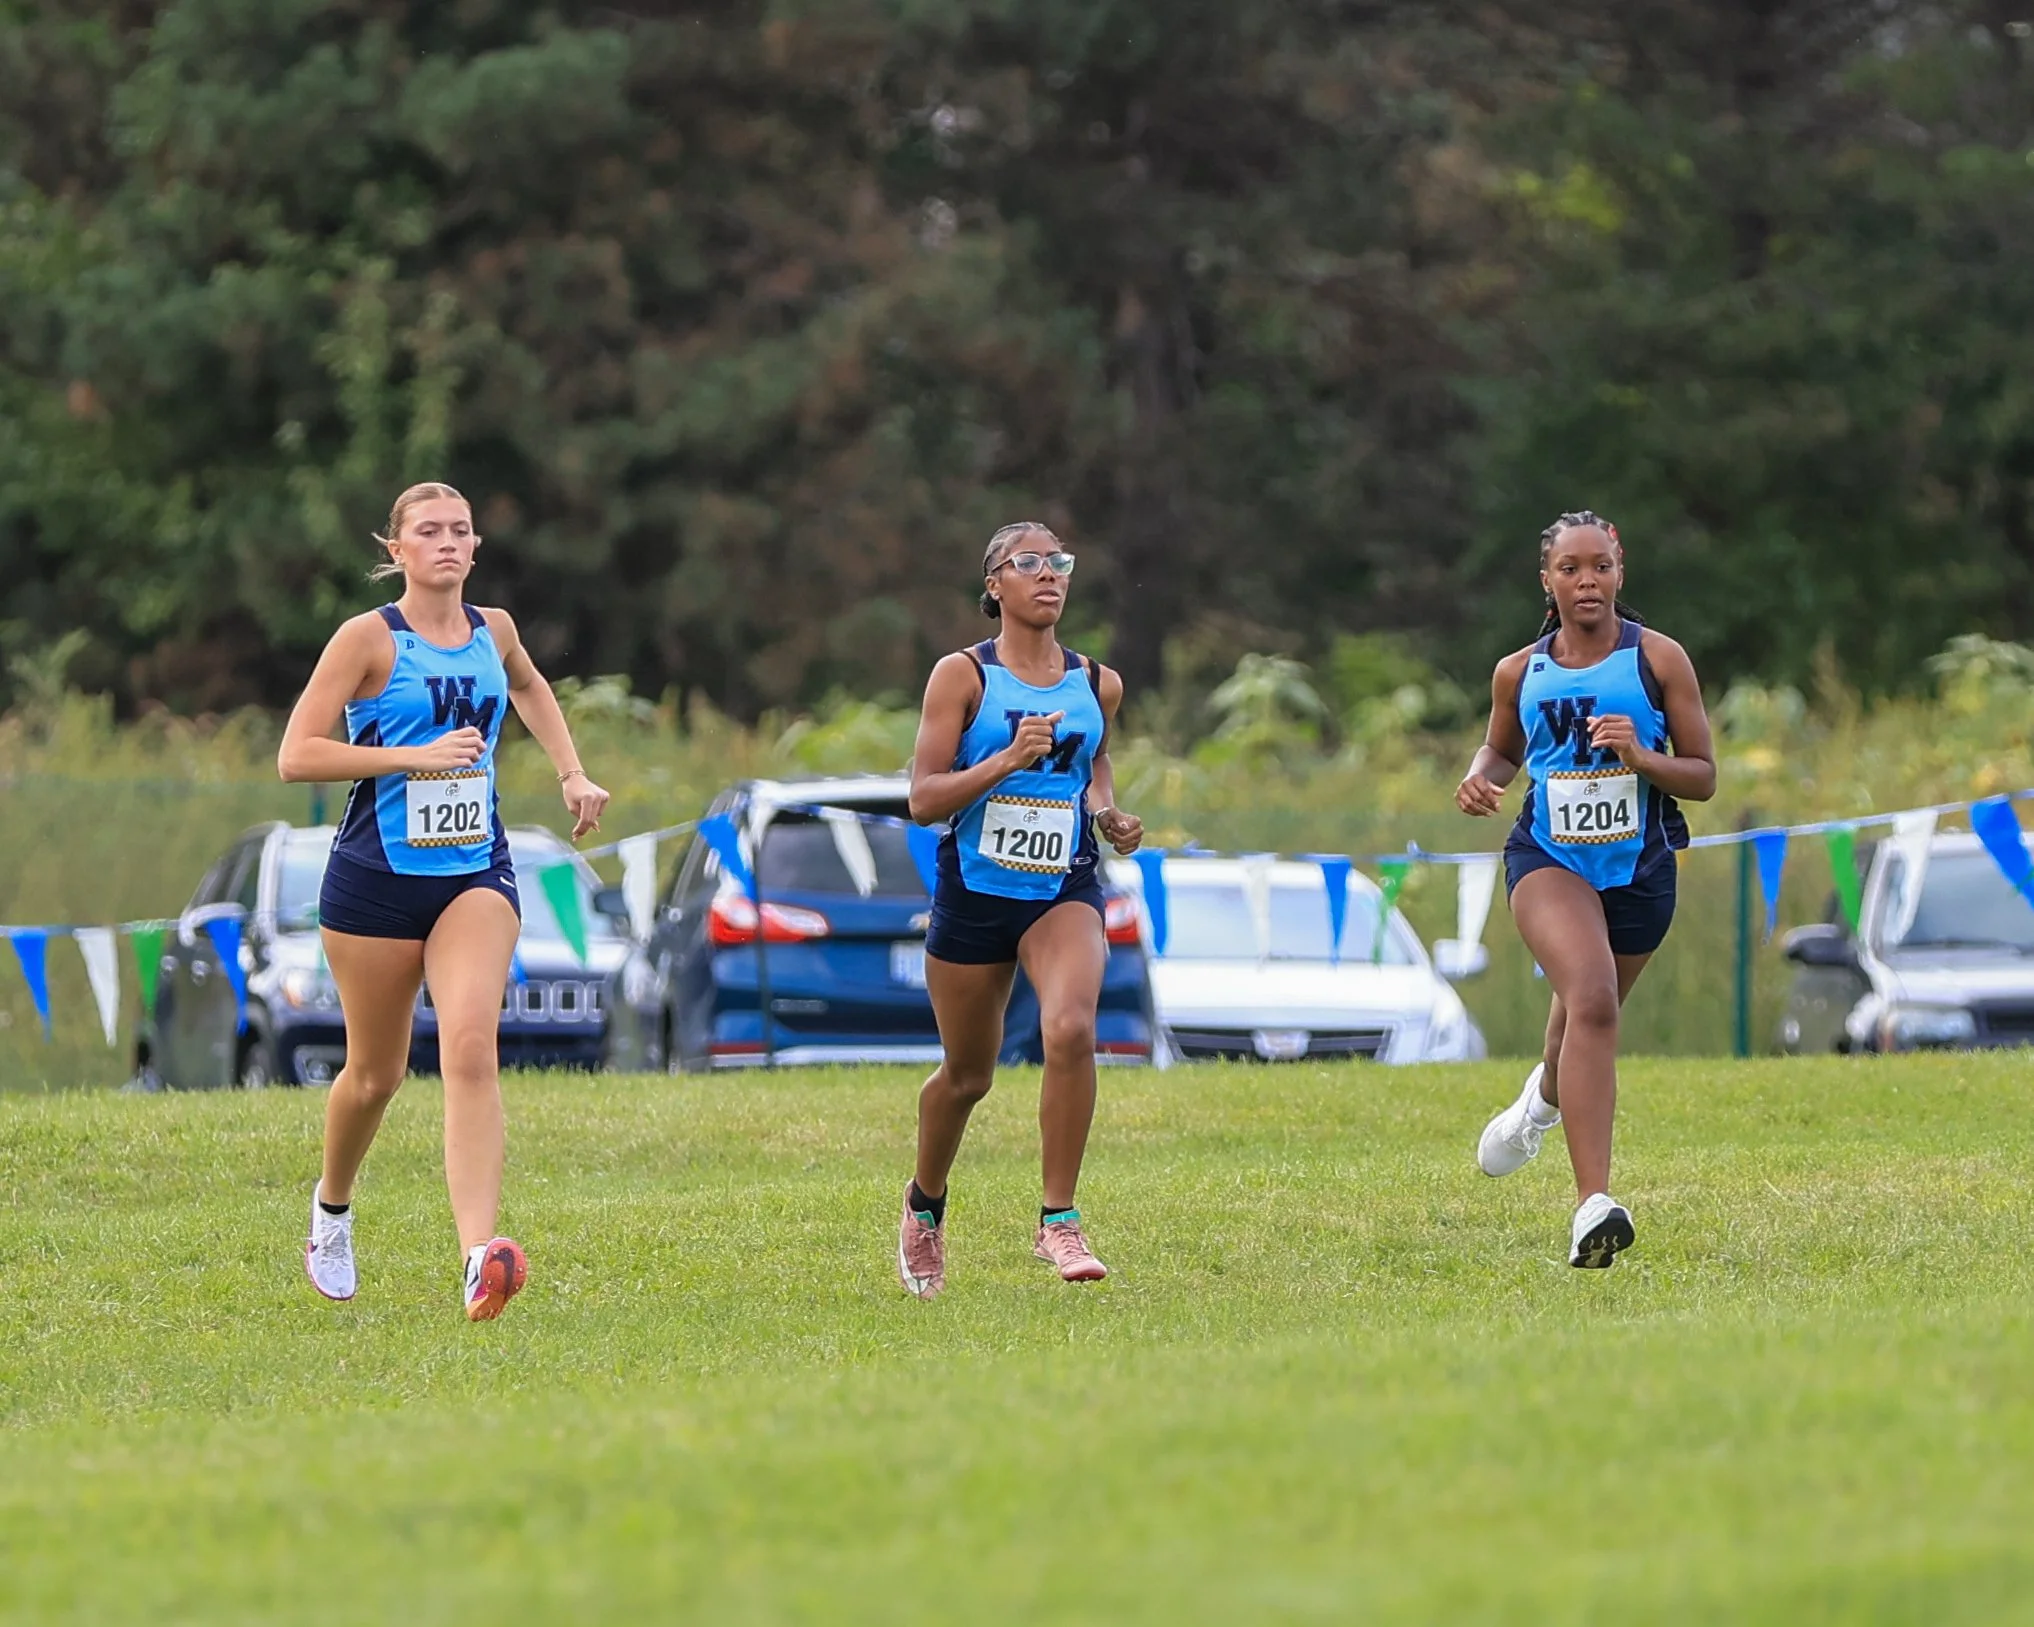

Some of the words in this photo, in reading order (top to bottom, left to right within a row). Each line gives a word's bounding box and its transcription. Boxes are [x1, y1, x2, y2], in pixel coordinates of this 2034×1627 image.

[418, 801, 481, 833] 1202
[1558, 799, 1630, 831] 1204
[992, 827, 1063, 861] 1200
